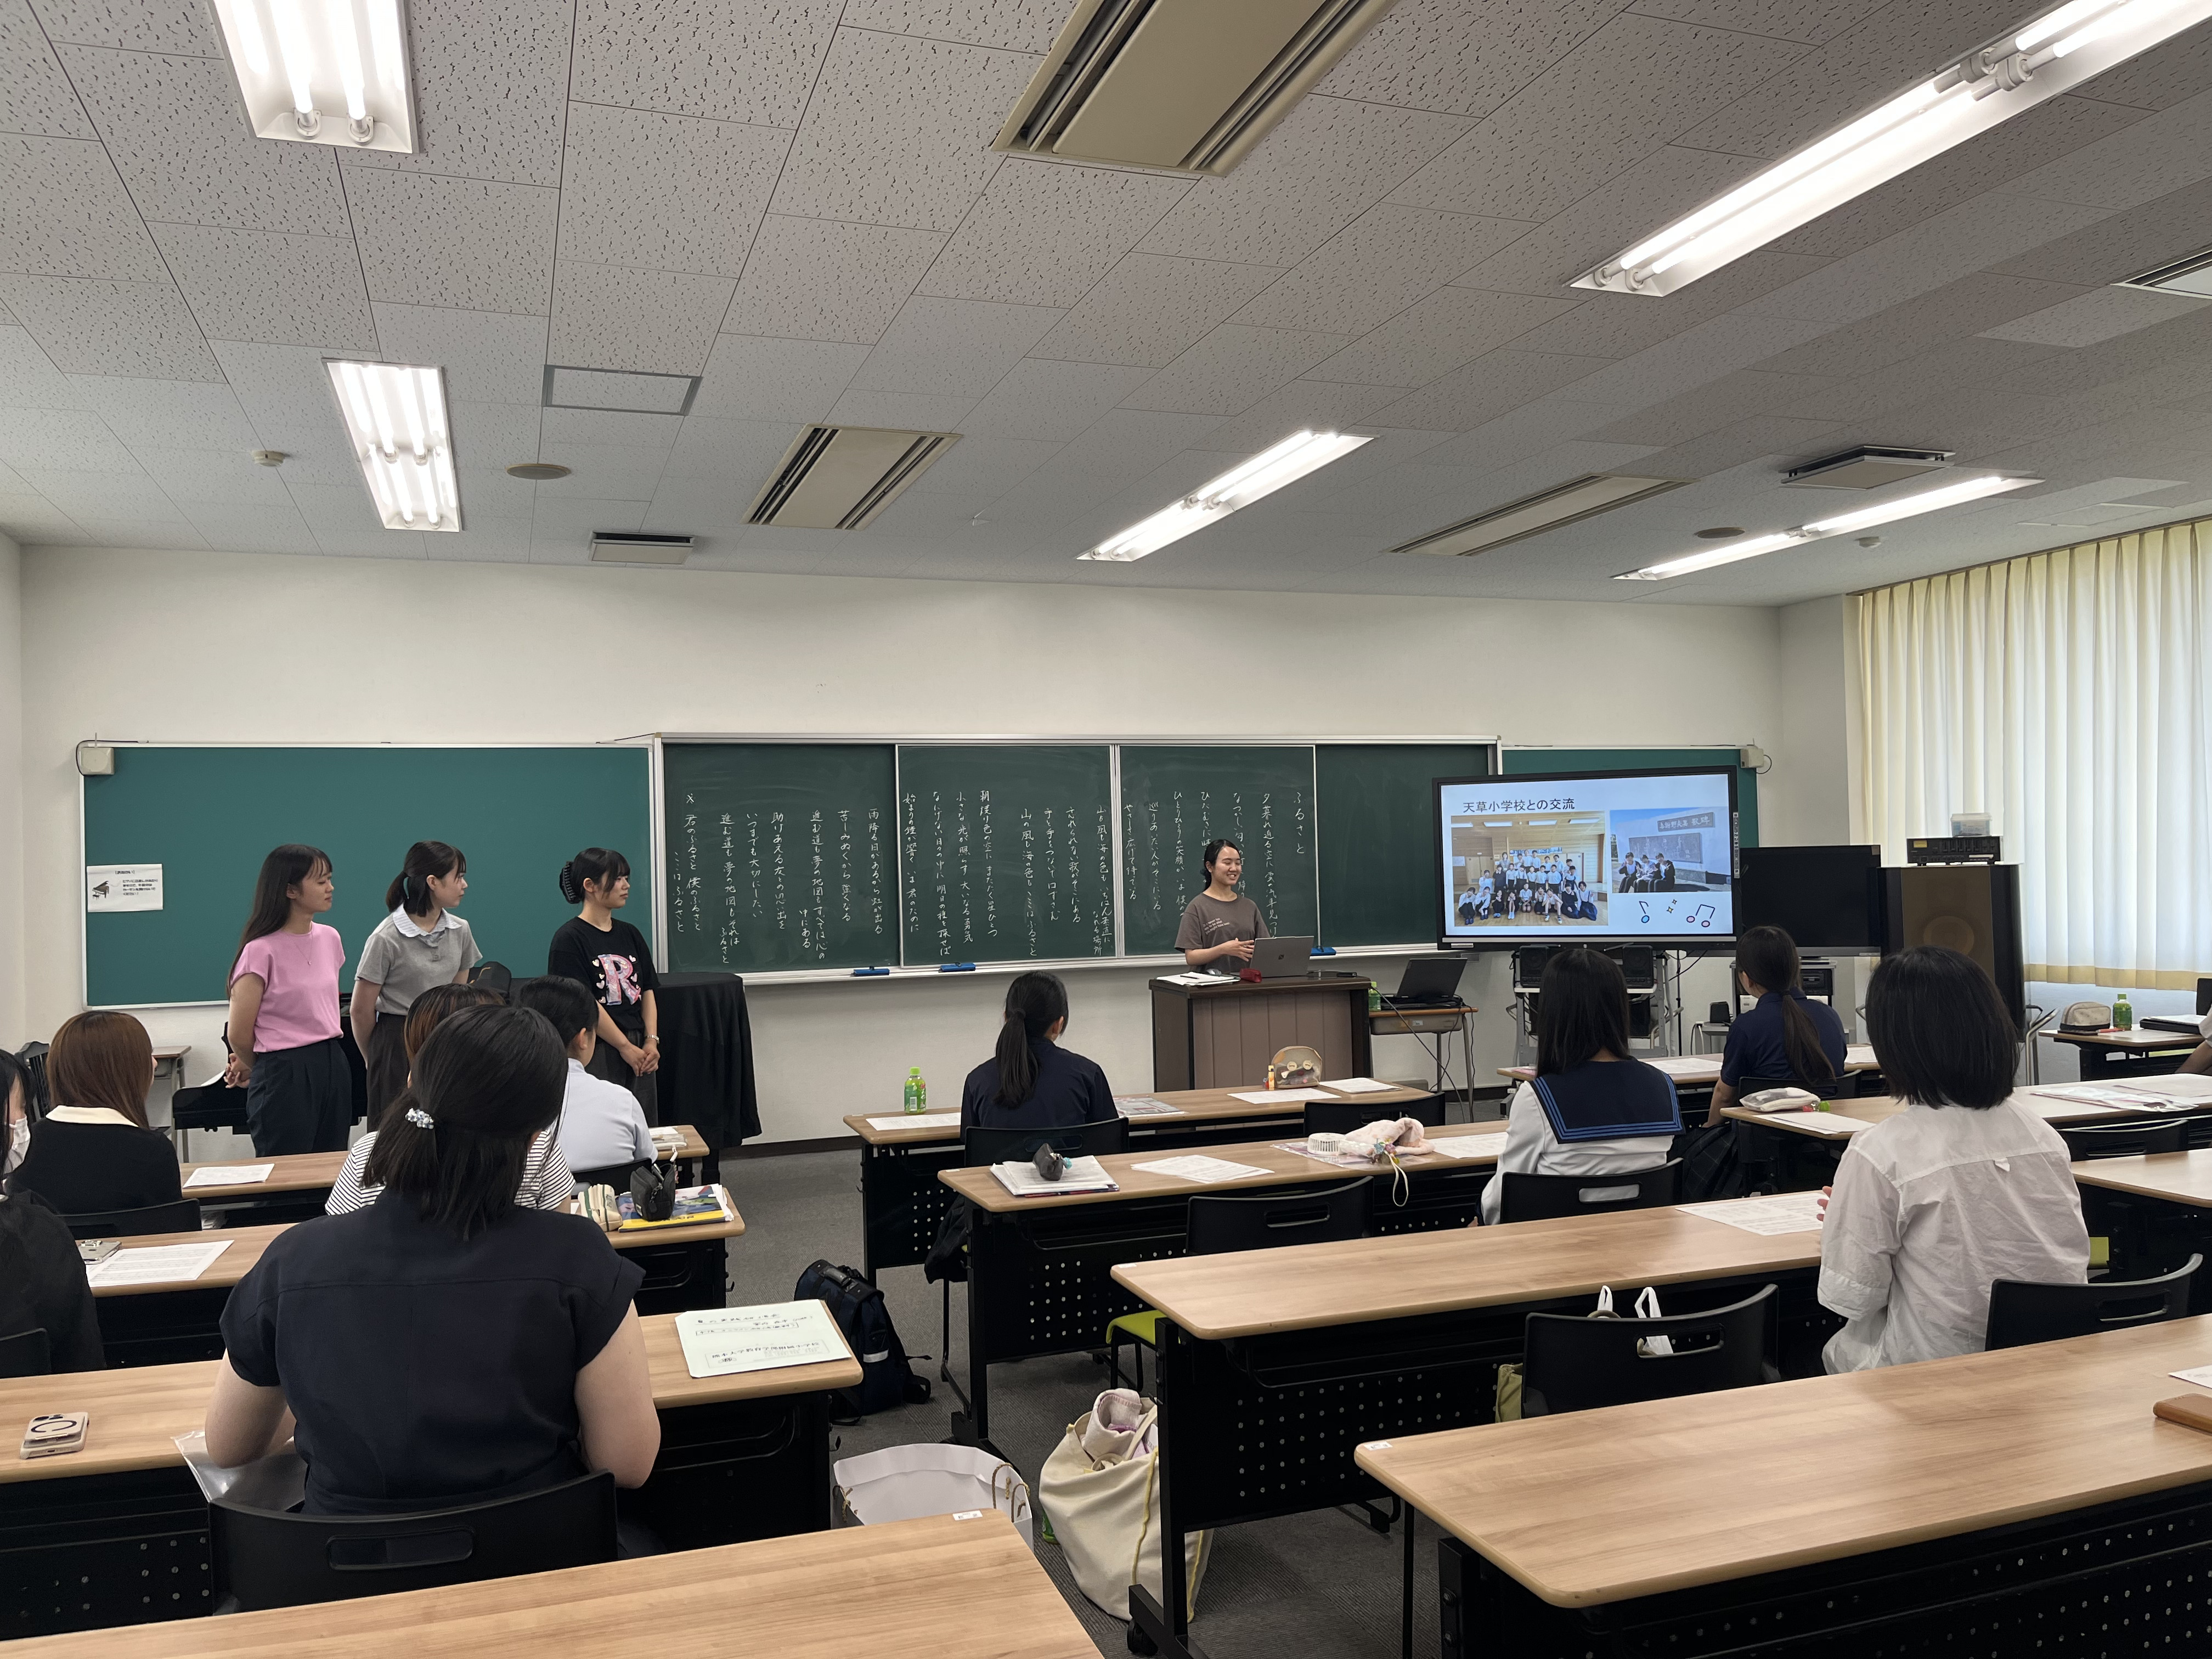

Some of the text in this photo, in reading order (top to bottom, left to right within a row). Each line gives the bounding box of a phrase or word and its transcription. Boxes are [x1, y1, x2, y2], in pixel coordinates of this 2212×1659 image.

[1293, 791, 1305, 855] ふるさと
[1463, 798, 1575, 812] 天草小学校との交流
[746, 812, 764, 918] いつまでも大切にしたい
[1065, 805, 1081, 923] 忘れられない歌がそこにある
[718, 926, 731, 964] ふるさと
[798, 907, 811, 949] 中にある
[597, 954, 641, 1005] R
